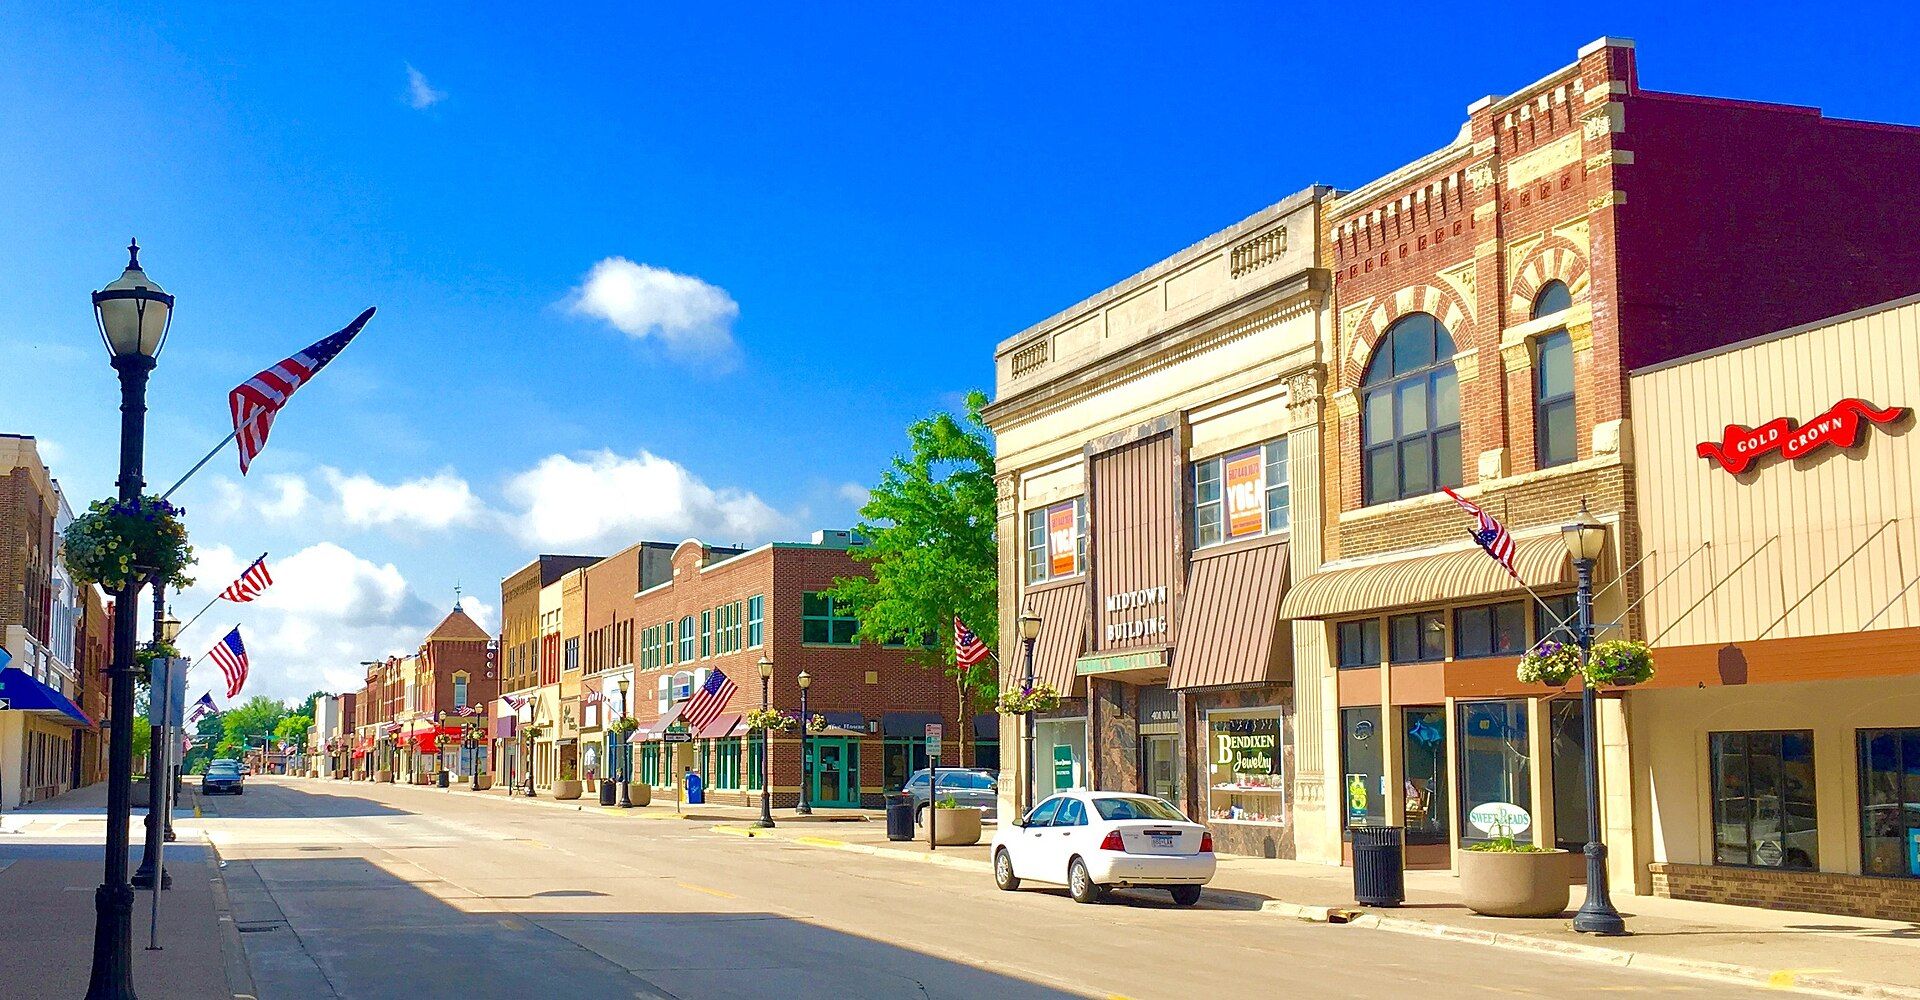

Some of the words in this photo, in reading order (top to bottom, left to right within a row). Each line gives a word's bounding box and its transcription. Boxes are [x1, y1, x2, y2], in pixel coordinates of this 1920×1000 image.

[1737, 428, 1778, 452] GOLD
[1788, 418, 1842, 451] CROWN
[1226, 478, 1262, 513] YOGA
[1106, 586, 1168, 612] MIDTOWN
[1106, 616, 1167, 641] BUILDING
[1217, 734, 1275, 764] BENDIXEN
[1233, 750, 1272, 774] Jewelry
